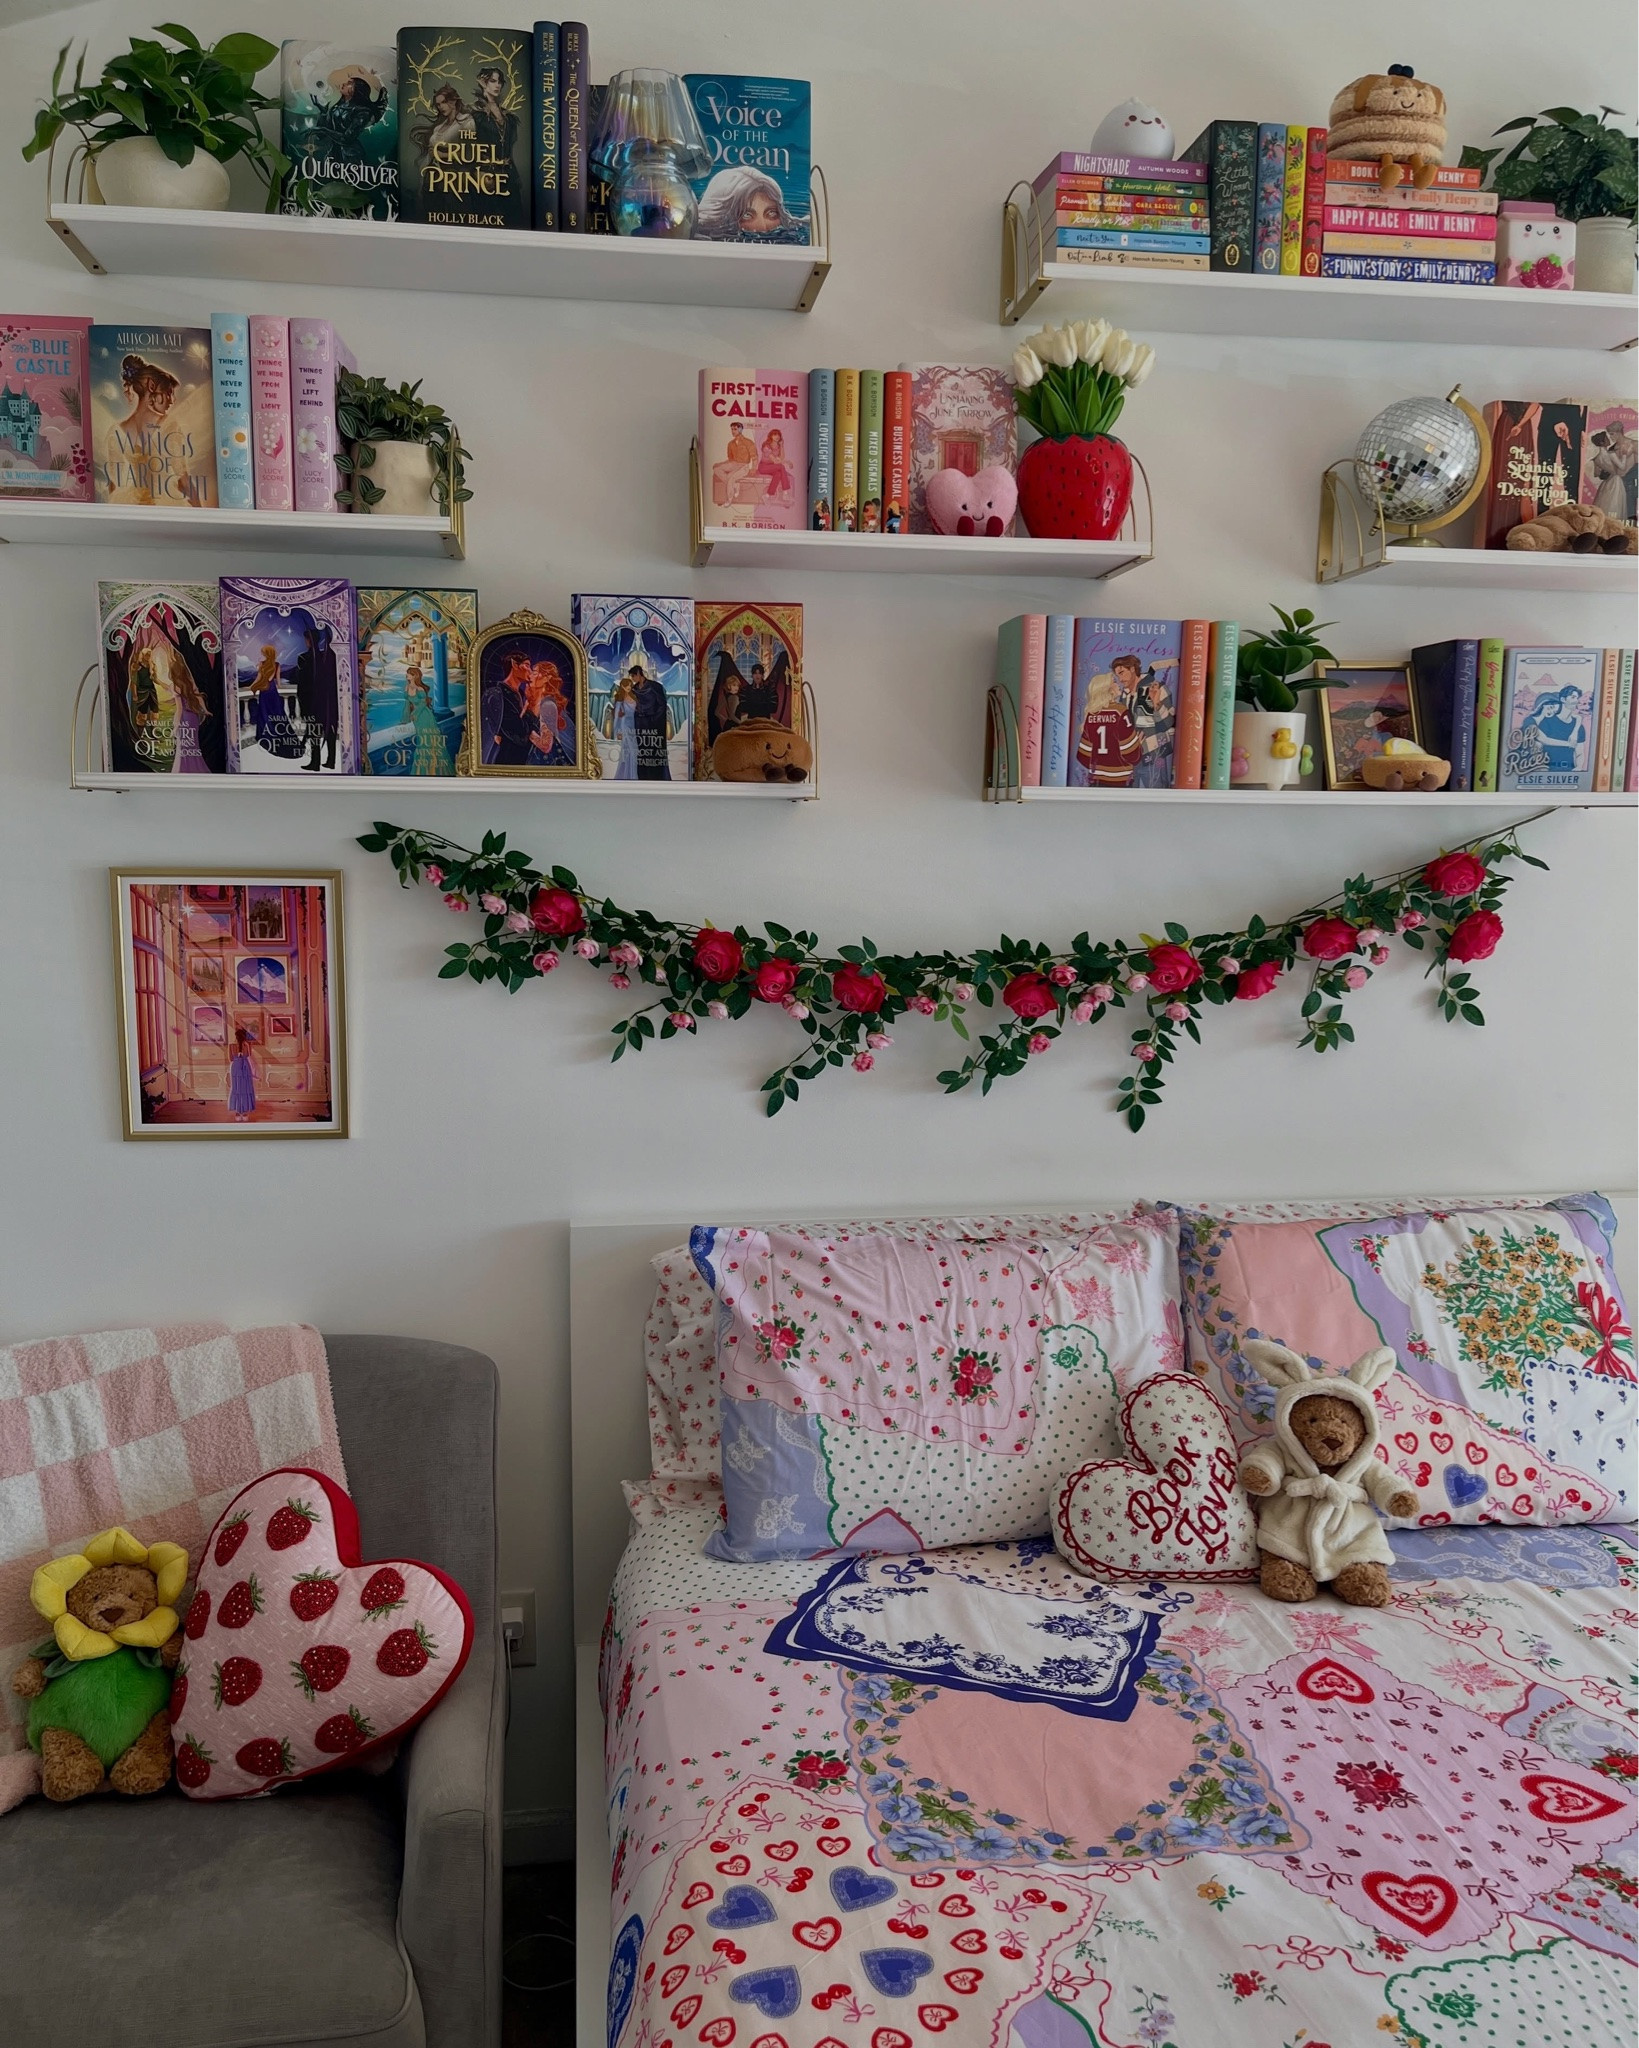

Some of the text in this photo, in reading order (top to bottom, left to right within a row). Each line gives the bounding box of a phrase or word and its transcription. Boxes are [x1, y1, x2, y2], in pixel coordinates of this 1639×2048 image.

[569, 73, 578, 85] THE
[565, 88, 582, 131] QUEEN
[706, 95, 782, 128] Voice
[458, 130, 477, 140] THE
[539, 71, 557, 190] THE WICKED KING
[722, 129, 769, 143] OF THE
[433, 142, 505, 165] CRUEL
[301, 156, 398, 189] QUICKSILVER
[568, 142, 582, 190] NOTHING
[1074, 154, 1189, 175] NIGHTSHADE AUTUMN WOODS
[1220, 165, 1250, 183] Little
[1351, 166, 1373, 178] BOOK
[1437, 171, 1466, 184] HENRY
[421, 167, 511, 202] PRINCE
[1215, 182, 1252, 198] Women
[1135, 201, 1153, 209] CARA
[1411, 191, 1441, 205] Emily
[1445, 194, 1478, 208] Henry
[428, 212, 505, 226] HOLLY BLACK
[1073, 212, 1101, 226] Ready
[1103, 216, 1113, 225] or
[1115, 213, 1135, 226] Not
[1332, 209, 1365, 226] HAPPY
[1368, 211, 1400, 229] PLACE
[1408, 213, 1440, 231] EMILY
[1444, 216, 1476, 233] HENRY
[1067, 251, 1082, 261] Out
[1092, 250, 1113, 263] Limb
[1334, 258, 1477, 282] FUNNY STORY EMILY HENRY
[29, 339, 70, 356] BLUE
[15, 358, 71, 376] CASTLE
[218, 358, 244, 366] THINGS
[298, 367, 323, 375] THINGS
[711, 382, 799, 398] FIRST-TIME
[940, 393, 985, 406] UNMAKING
[299, 399, 324, 407] BEHIND
[711, 398, 798, 420] CALLER
[820, 389, 828, 416] BORISON
[895, 392, 903, 420] BORISON
[930, 405, 993, 420] JUNE FARROW
[115, 430, 194, 458] WINGS
[148, 456, 172, 473] OF
[818, 423, 829, 494] LOVELIGHT FARMS
[843, 433, 854, 488] IN THE WEEDS
[868, 431, 879, 492] MIXED SIGNALS
[892, 426, 904, 499] BUSINESS CASUAL
[1510, 446, 1532, 464] The
[223, 473, 246, 481] SCORE
[225, 466, 244, 474] LUCY
[262, 474, 285, 482] SCORE
[302, 476, 325, 484] SCORE
[1507, 461, 1568, 482] Spanish
[1497, 481, 1576, 506] Deception
[745, 522, 786, 530] BORISON
[1094, 622, 1167, 635] ELSIE SILVER
[1028, 619, 1039, 682] ELSIE SILVER
[1054, 619, 1066, 682] ELSIE SILVER
[1084, 632, 1174, 658] Powerless
[1191, 624, 1203, 686] ELSIE SILVER
[1222, 624, 1235, 687] ELSIE SILVER
[1481, 661, 1499, 720] Yours Truly
[1606, 678, 1614, 706] SILVER
[1622, 679, 1631, 706] SILVER
[262, 722, 278, 737] A
[1088, 714, 1117, 724] GERVAIS
[1123, 715, 1132, 727] 1
[141, 727, 196, 740] A COURT
[401, 734, 448, 748] COURT
[1025, 705, 1039, 760] Flawless
[1048, 705, 1065, 771] Heartless
[1097, 726, 1108, 755] 1
[1507, 726, 1538, 750] Off
[135, 739, 163, 763] OF
[257, 737, 302, 753] OF MIST
[384, 749, 412, 767] OF
[1504, 752, 1550, 776] Races
[1518, 775, 1580, 784] ELSIE SILVER
[1128, 1436, 1201, 1544] BOOK
[1175, 1446, 1237, 1564] LOVER
